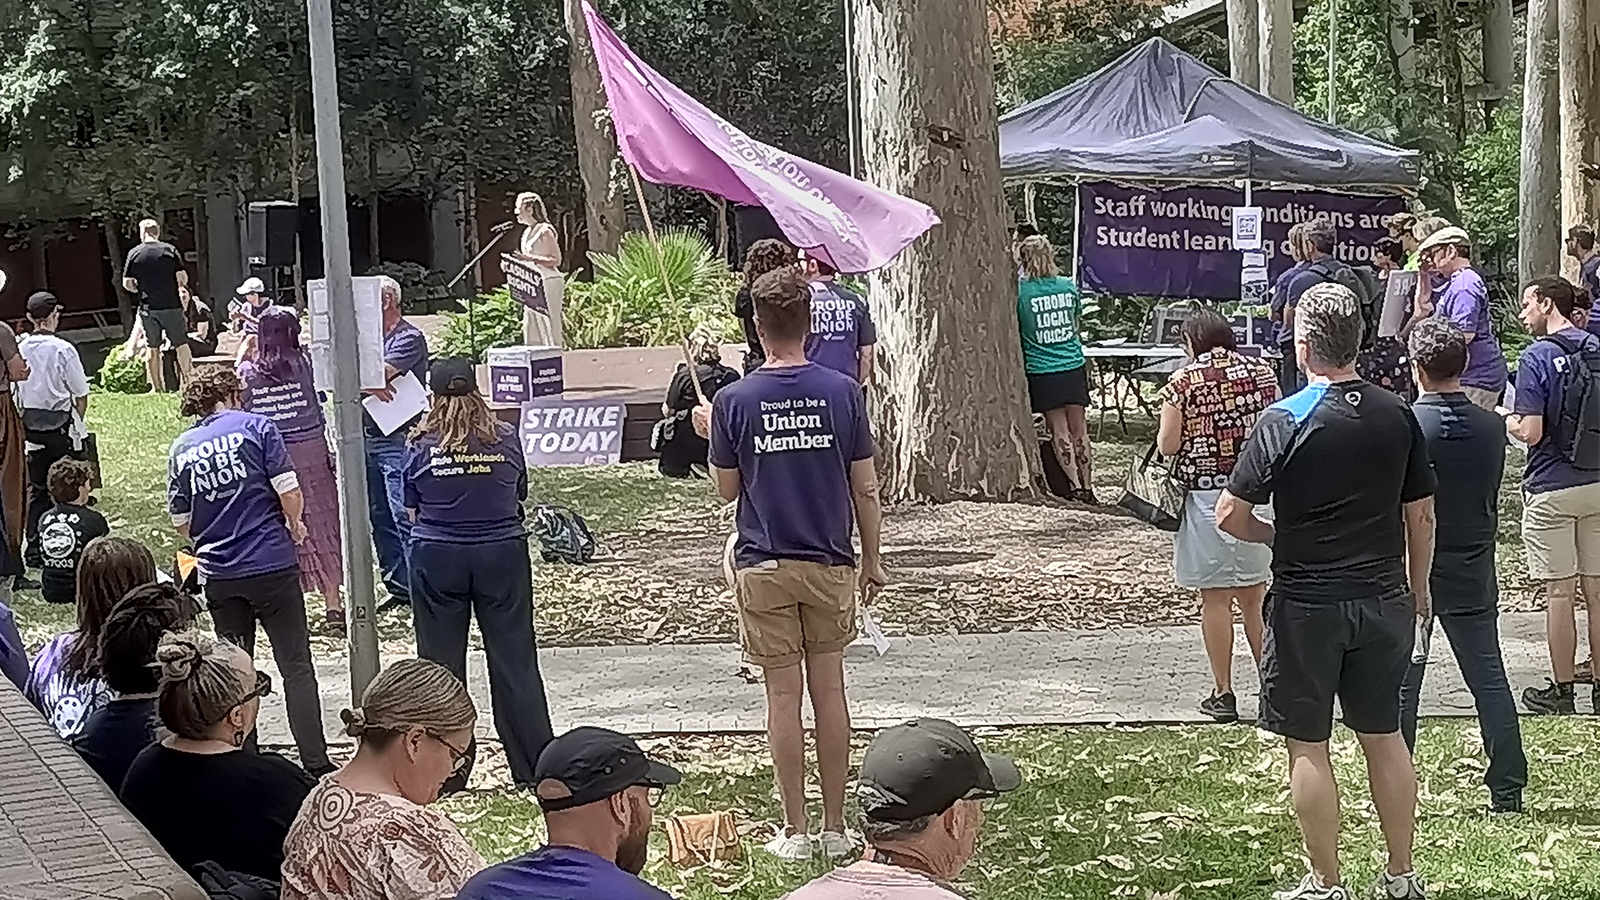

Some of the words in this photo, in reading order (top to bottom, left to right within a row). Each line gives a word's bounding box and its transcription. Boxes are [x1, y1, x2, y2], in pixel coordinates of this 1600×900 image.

[1094, 195, 1147, 218] Staff
[1151, 197, 1232, 226] working
[1096, 226, 1181, 250] Student
[1030, 292, 1076, 313] STRONG
[835, 309, 853, 321] BE
[1036, 310, 1071, 328] LOCAL
[760, 399, 791, 411] Proud
[793, 399, 804, 408] to
[805, 397, 818, 408] be
[819, 399, 827, 407] a
[524, 406, 620, 430] STRIKE
[761, 410, 823, 432] Union
[525, 430, 618, 454] TODAY
[753, 430, 834, 454] Member
[176, 432, 244, 476] PROUD
[214, 447, 241, 470] BE
